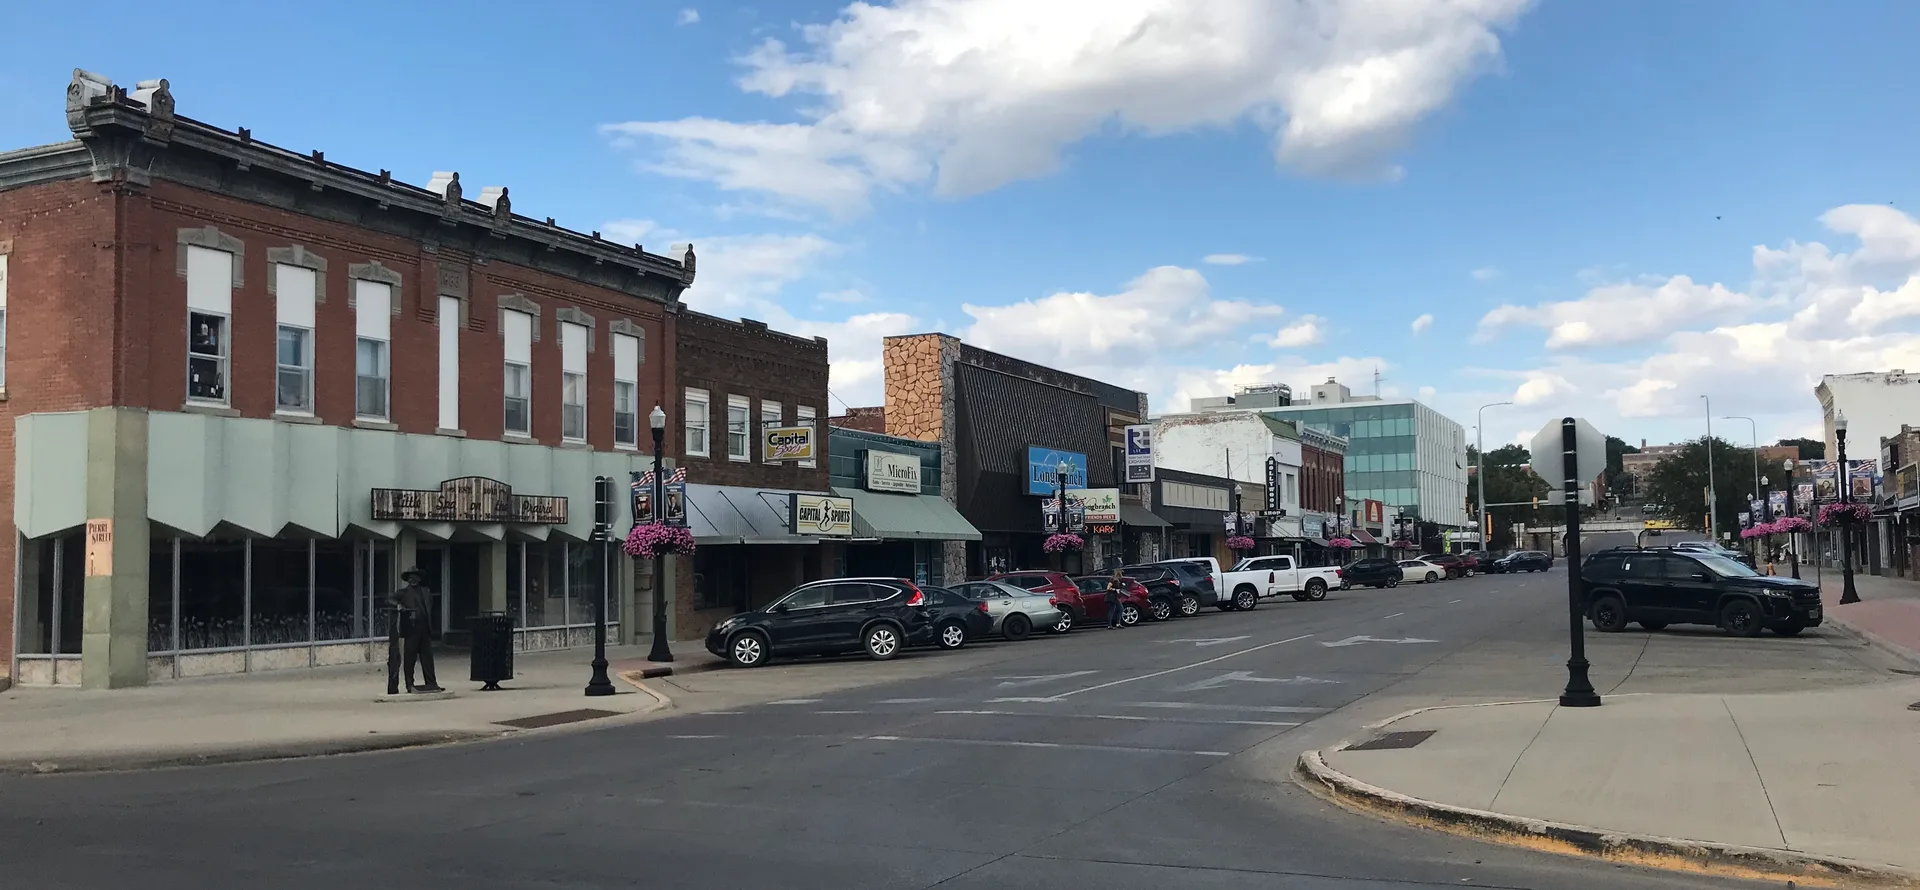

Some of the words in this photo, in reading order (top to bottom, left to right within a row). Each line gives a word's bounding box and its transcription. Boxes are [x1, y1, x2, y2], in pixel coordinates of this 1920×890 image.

[769, 431, 809, 446] Capital
[888, 464, 918, 480] MicroFix
[1032, 465, 1083, 487] Longbanch
[393, 493, 421, 508] Little
[436, 495, 457, 511] Spa
[522, 500, 553, 515] Prairie
[1084, 502, 1116, 512] ongbranch
[799, 508, 821, 521] CAPITAL
[831, 509, 850, 523] SPORTS
